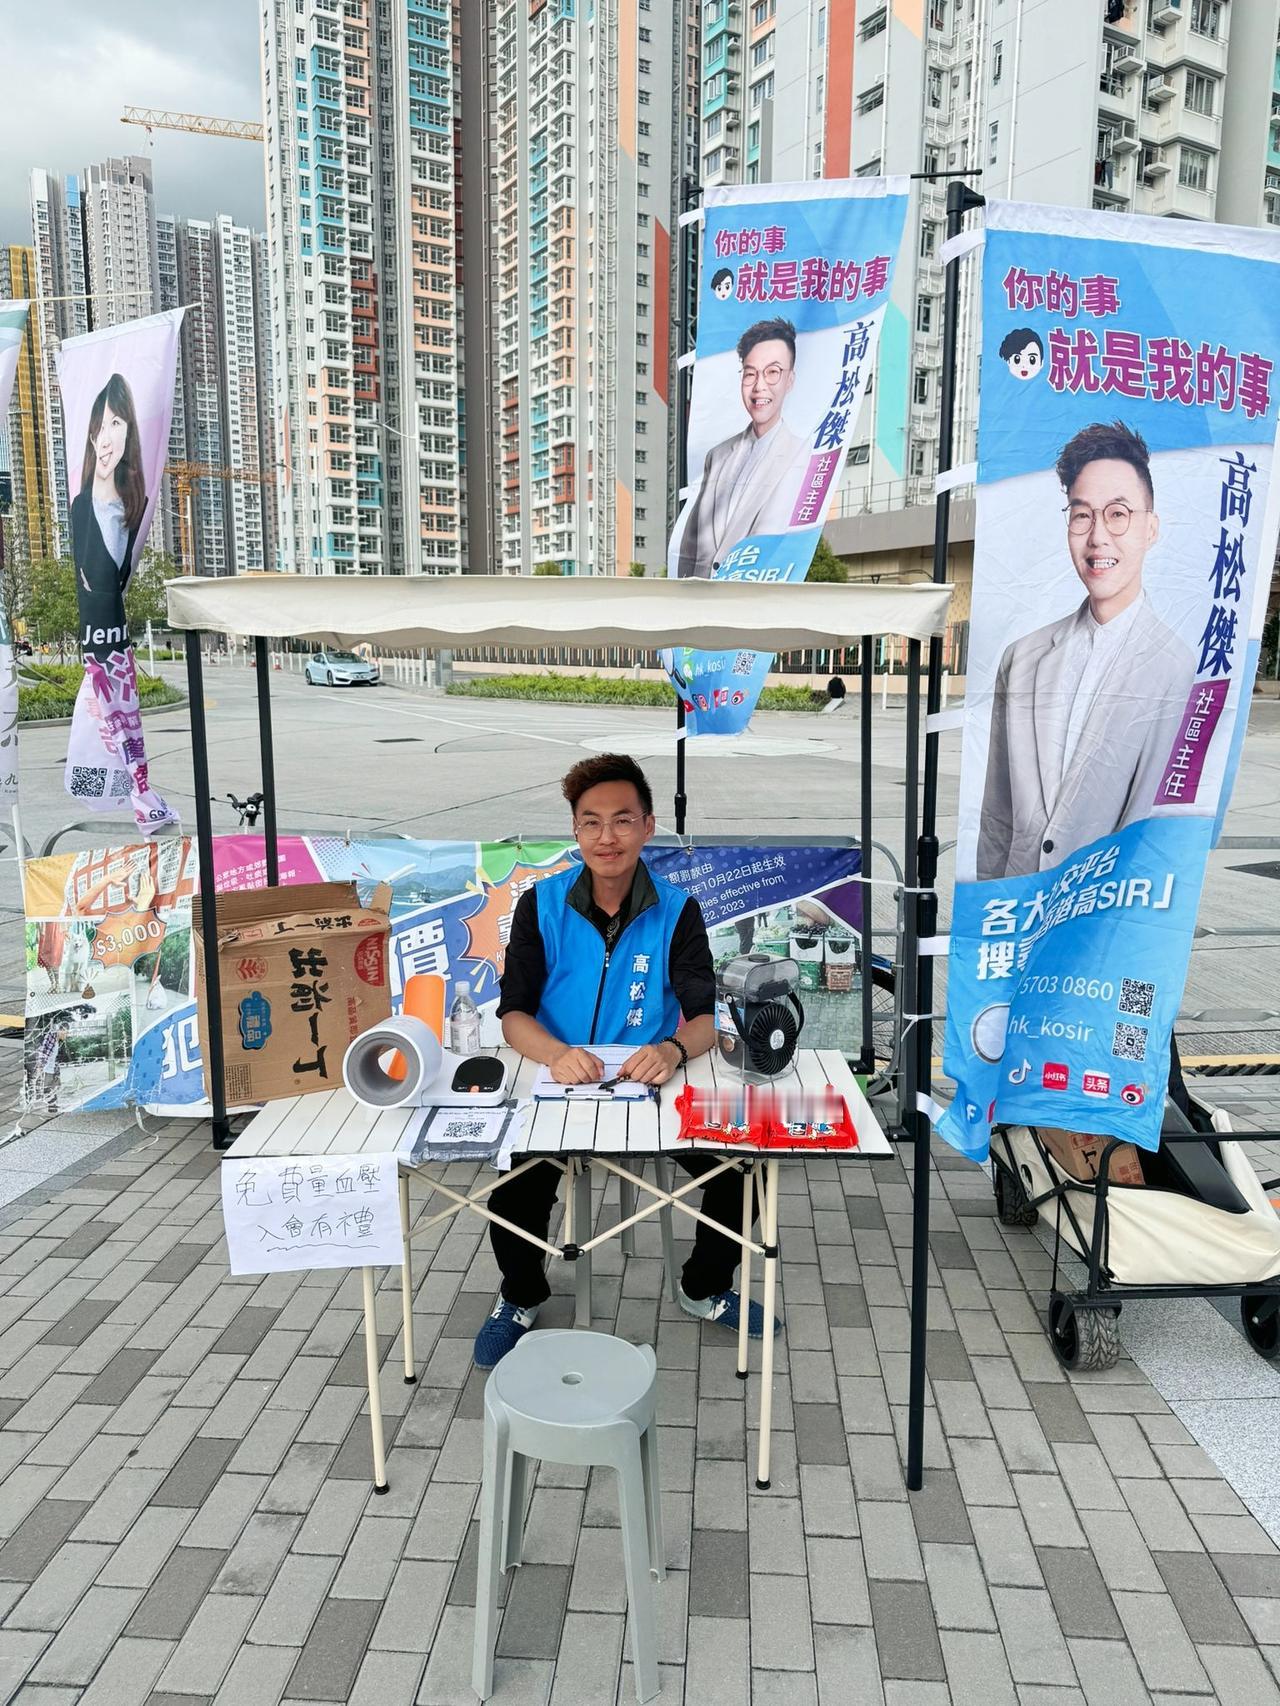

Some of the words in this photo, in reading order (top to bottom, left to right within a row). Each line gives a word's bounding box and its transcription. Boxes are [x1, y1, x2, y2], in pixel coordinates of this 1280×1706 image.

[714, 226, 787, 258] 你的事
[736, 255, 892, 302] 就是我的事
[1002, 266, 1121, 319] 你的事
[813, 321, 872, 450] 高松傑
[1047, 327, 1274, 420] 就是我的事
[796, 456, 833, 522] 社區主任
[1197, 450, 1257, 677] 高松傑
[1163, 687, 1215, 797] 社區主任
[720, 881, 761, 901] effective
[762, 873, 785, 888] from
[720, 899, 746, 914] 2023
[95, 918, 162, 957] $3,000
[364, 936, 381, 982] NISSIN
[625, 953, 651, 1028] 高松傑
[1020, 975, 1059, 995] 5703
[1062, 975, 1114, 1001] 0860
[288, 947, 332, 1079] 出前一丁
[1008, 1014, 1094, 1042] hk_kosir
[1086, 1077, 1108, 1092] 头条
[235, 1163, 382, 1206] 免費量血壓
[257, 1206, 375, 1242] 入會有禮
